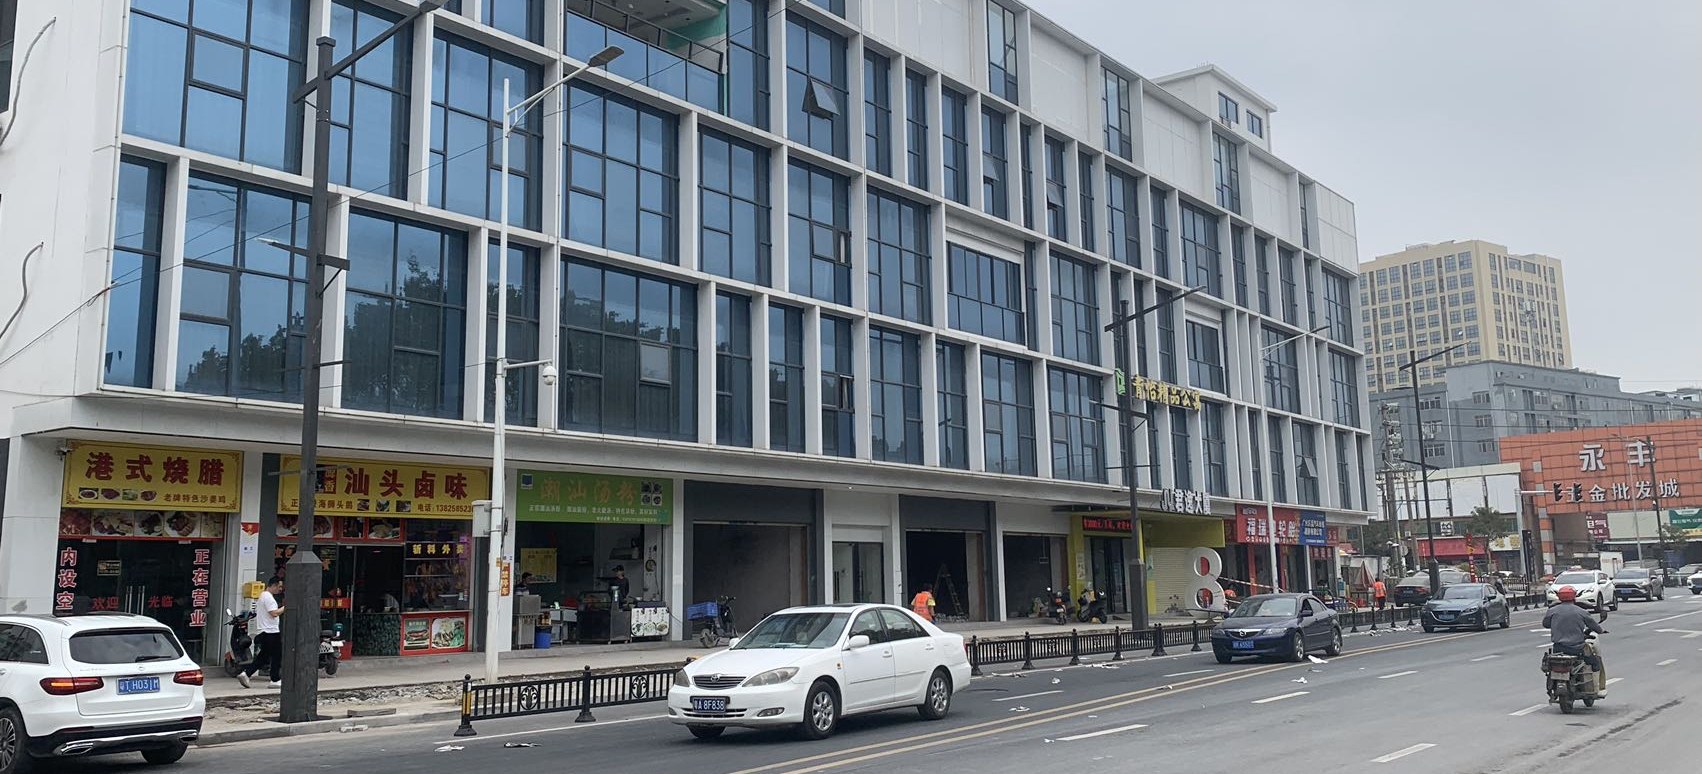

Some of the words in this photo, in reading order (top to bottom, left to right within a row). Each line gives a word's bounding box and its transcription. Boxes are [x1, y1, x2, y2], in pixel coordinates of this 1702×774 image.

[85, 451, 224, 486] 港式烧腊
[1578, 440, 1656, 472] 永丰
[163, 493, 226, 504] 老牌特色沙姜鸡
[344, 467, 468, 500] 汕头卤味
[56, 547, 78, 610] 内设空
[189, 549, 210, 627] 正在营业
[92, 596, 120, 610] 欢迎
[148, 596, 174, 608] 光临
